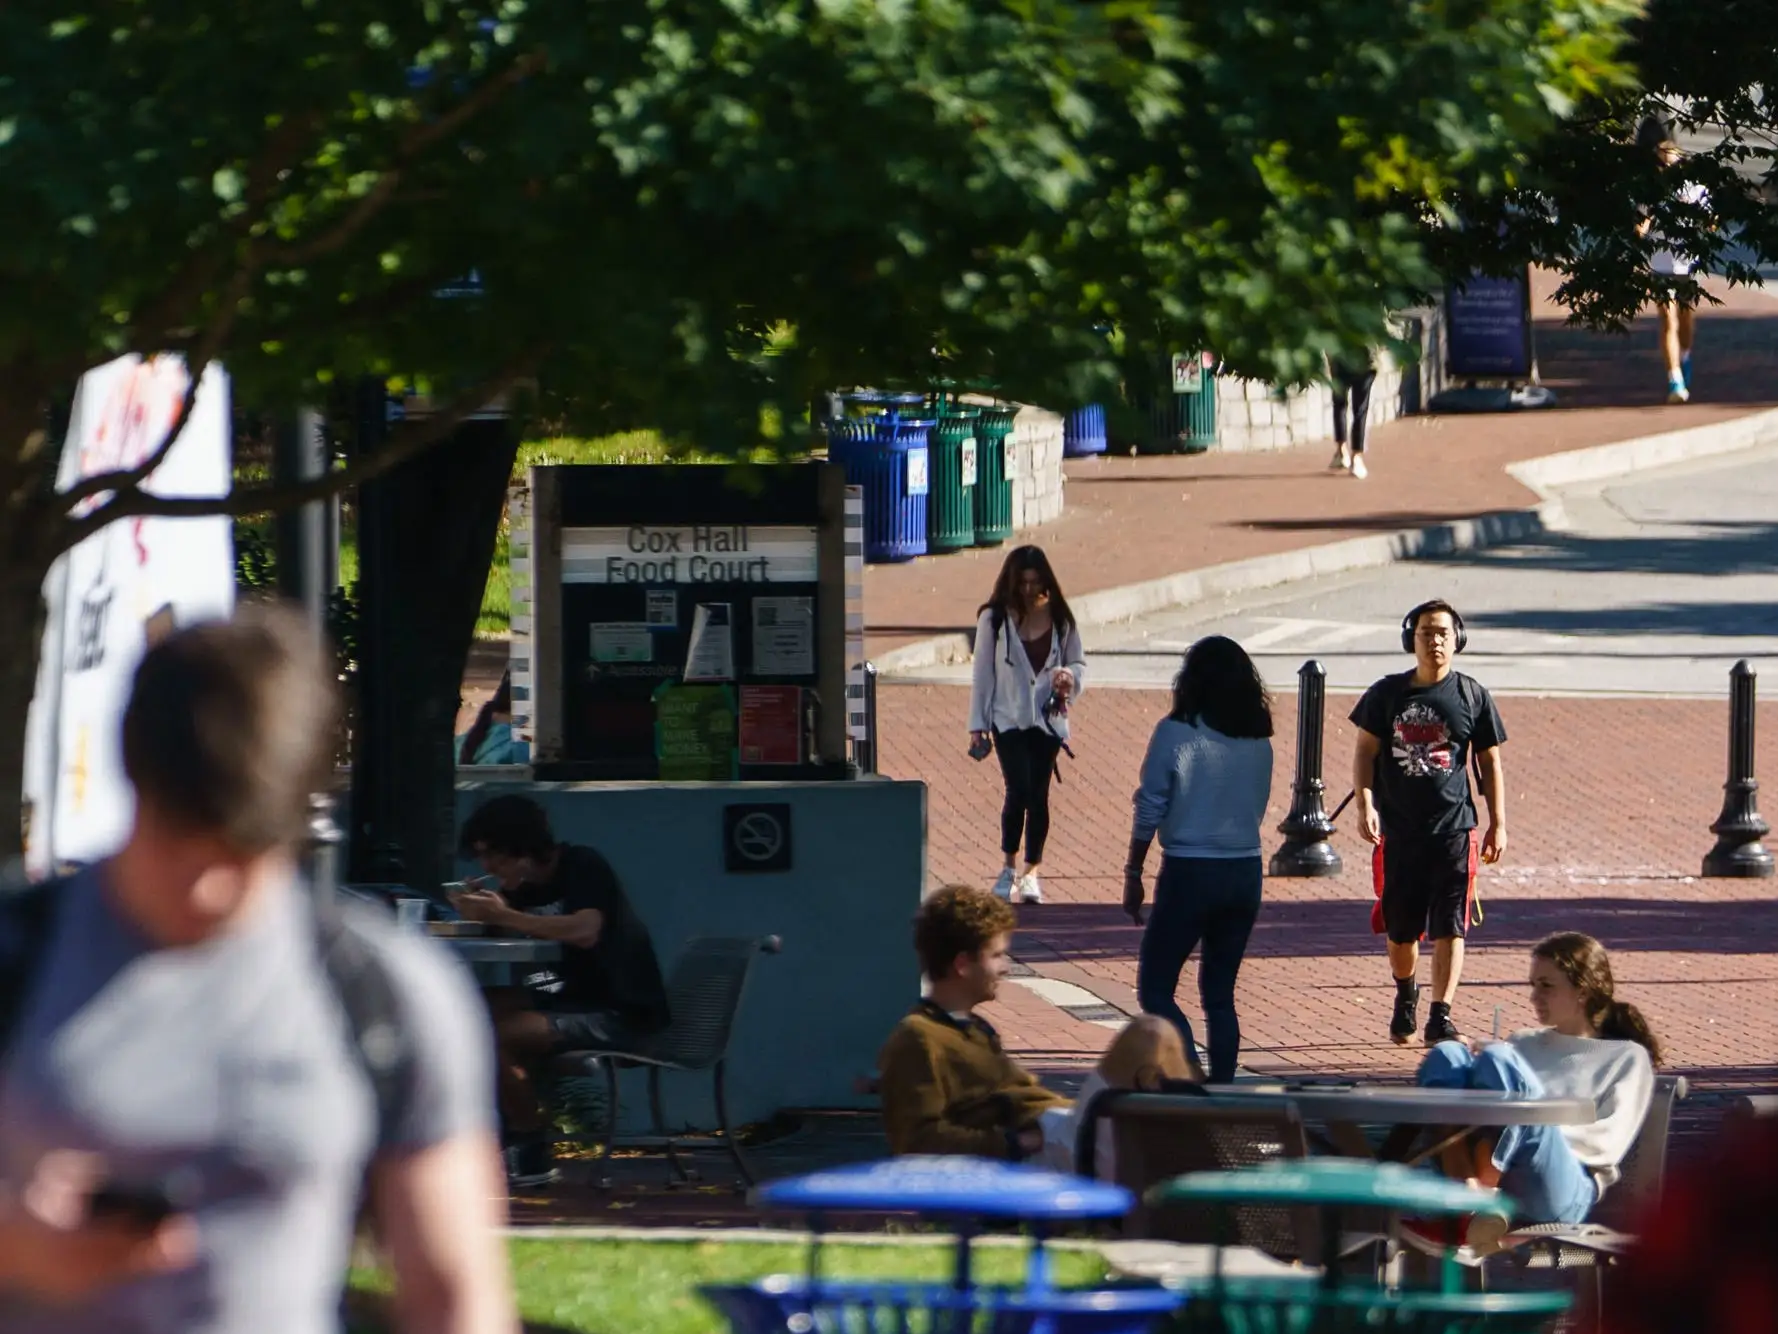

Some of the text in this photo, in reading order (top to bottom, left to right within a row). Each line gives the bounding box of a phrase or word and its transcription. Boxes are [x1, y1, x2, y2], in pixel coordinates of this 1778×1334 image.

[626, 523, 749, 553] Cox Hall
[605, 555, 770, 583] Food Court
